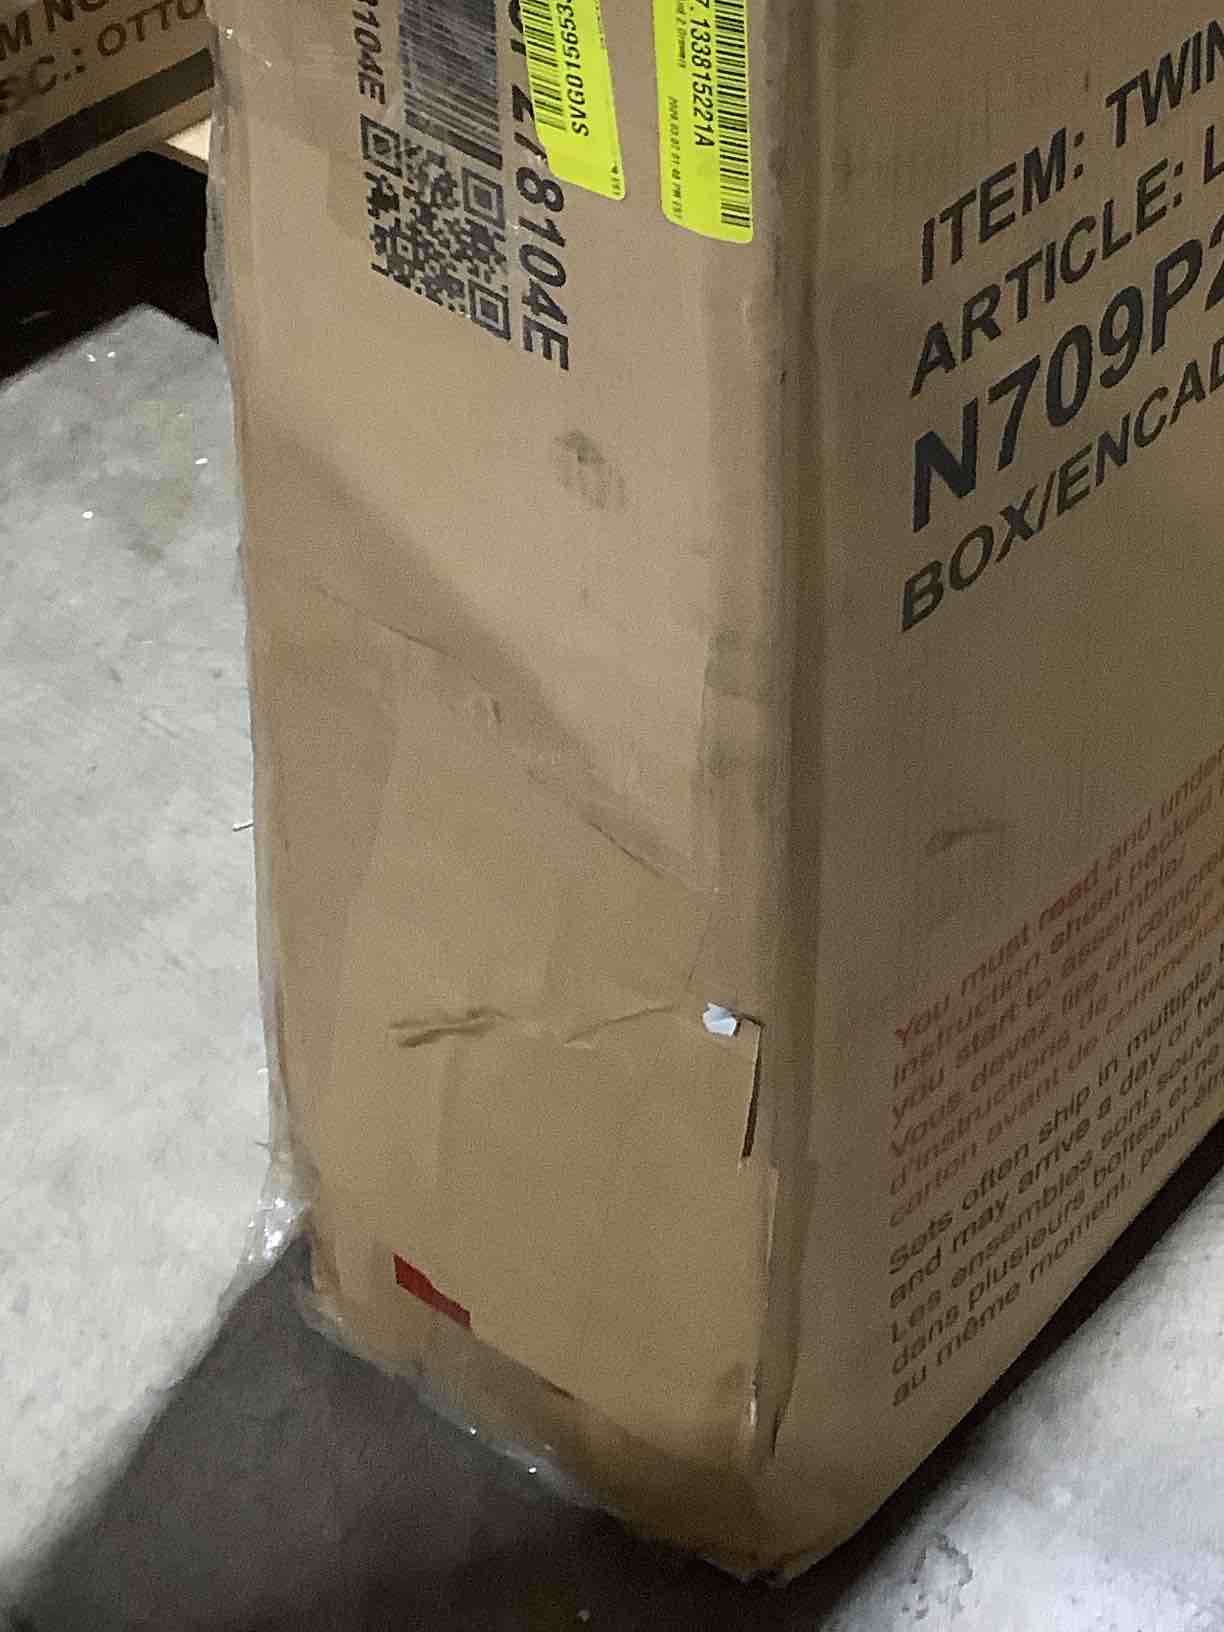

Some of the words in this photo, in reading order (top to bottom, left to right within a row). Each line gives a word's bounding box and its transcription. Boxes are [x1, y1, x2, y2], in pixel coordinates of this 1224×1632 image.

[912, 161, 1183, 395] ARTICLE:
[922, 129, 1084, 282] ITEM:
[894, 993, 950, 1049] You
[960, 922, 1030, 997] must
[1107, 809, 1152, 872] and
[889, 1091, 962, 1159] Vous
[970, 1012, 1052, 1094] devez
[889, 1003, 1073, 1219] d'instructions
[1078, 991, 1109, 1030] de
[889, 1210, 953, 1276] Sets
[961, 1142, 1030, 1212] often
[1038, 1085, 1091, 1145] ship
[1097, 1056, 1120, 1089] in
[1126, 962, 1213, 1059] multiple
[889, 1142, 978, 1229] carton
[986, 1066, 1060, 1146] avant
[1066, 1035, 1099, 1073] de
[889, 1245, 942, 1310] and
[951, 1192, 1009, 1254] may
[1017, 1117, 1091, 1195] arrive
[1119, 1044, 1162, 1097] day
[1167, 1014, 1190, 1048] or
[891, 1066, 945, 1131] you
[955, 1001, 1017, 1069] start
[1026, 976, 1052, 1009] to
[890, 1289, 942, 1345] Les
[949, 1150, 1093, 1311] ensembles
[1100, 1087, 1149, 1152] sont
[891, 1304, 960, 1376] dans
[966, 1165, 1088, 1326] plusieurs
[1092, 1107, 1162, 1190] boîtes
[1167, 1074, 1189, 1110] et
[1193, 1043, 1221, 1083] ne
[892, 1364, 928, 1407] au
[936, 1263, 1021, 1367] même
